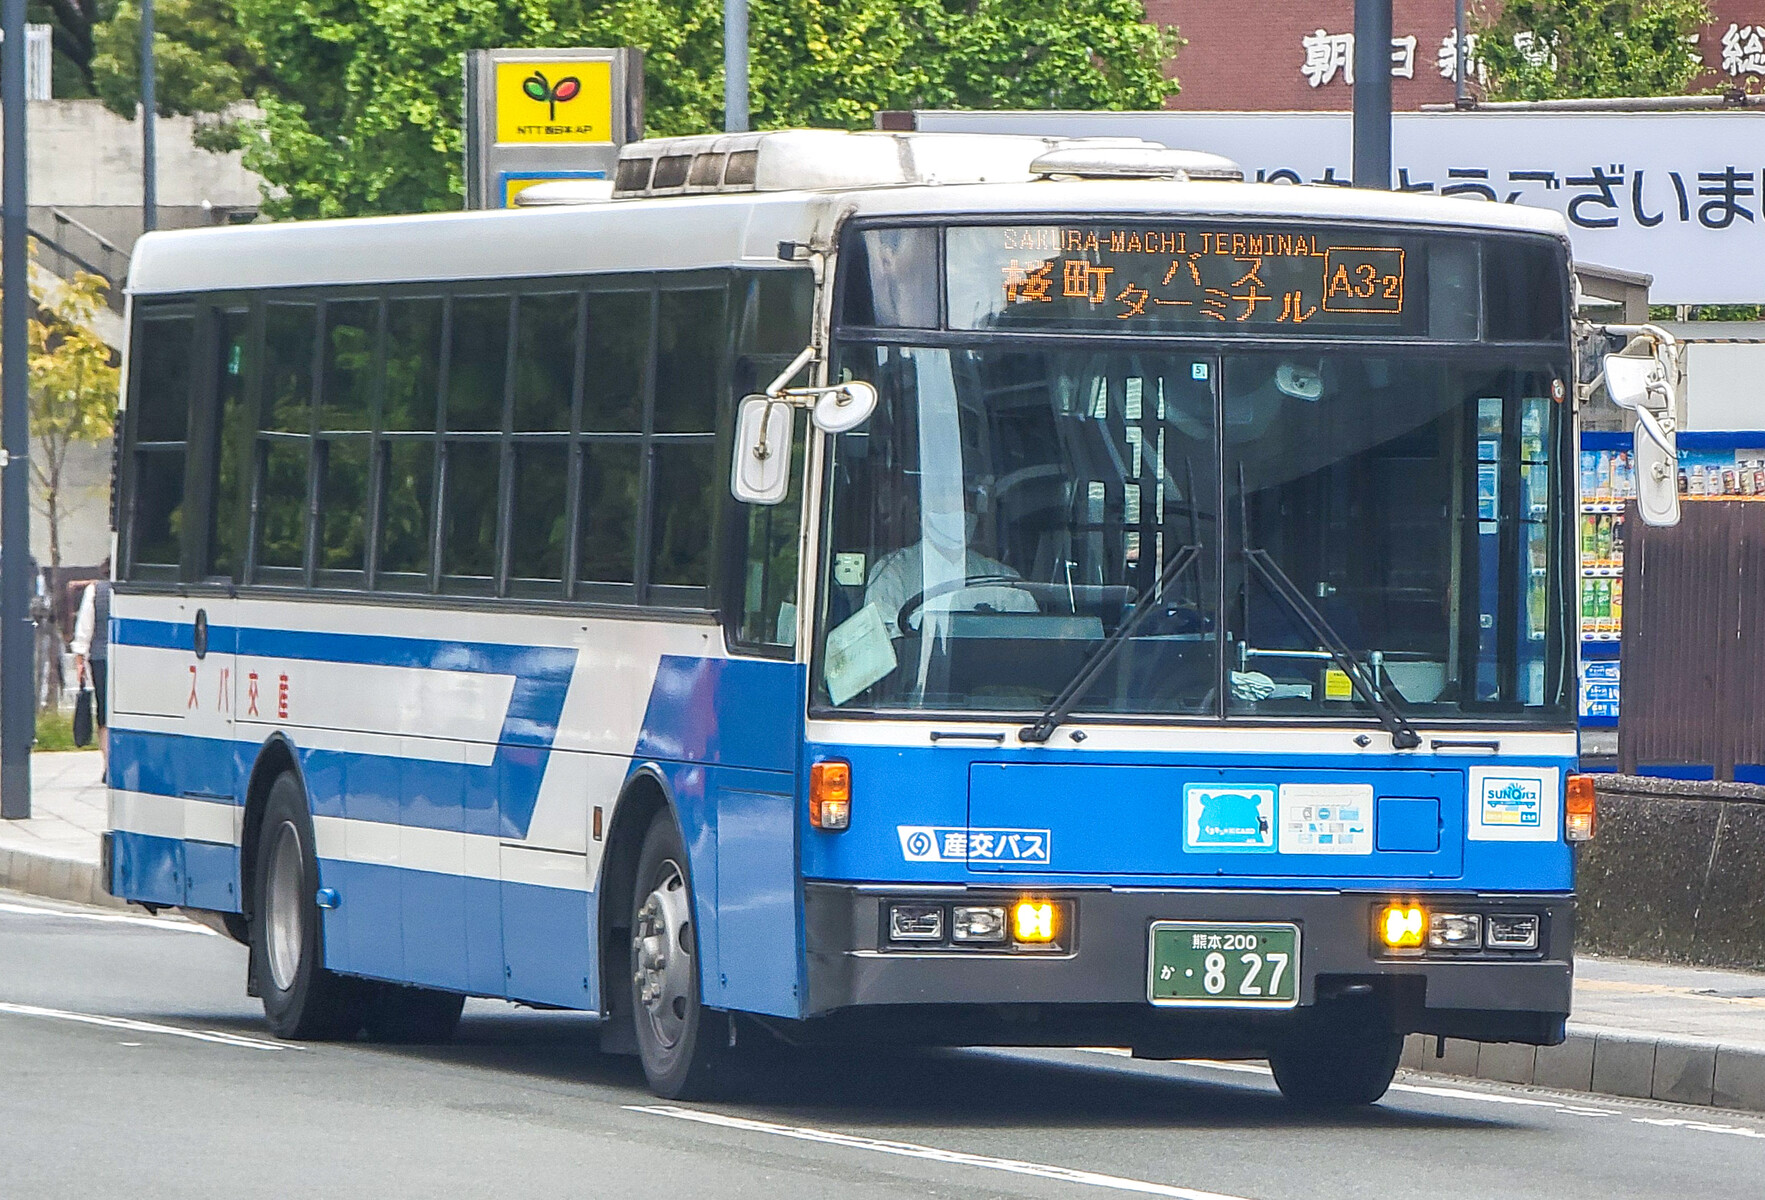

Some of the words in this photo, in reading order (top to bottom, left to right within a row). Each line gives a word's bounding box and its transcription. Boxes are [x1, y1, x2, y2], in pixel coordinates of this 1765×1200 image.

[1004, 228, 1187, 254] SAKURA-MACHI
[1200, 232, 1325, 257] TERMINAL
[1328, 264, 1399, 299] A3-2
[942, 833, 1046, 859] 産交バス
[1192, 933, 1257, 950] 熊本200
